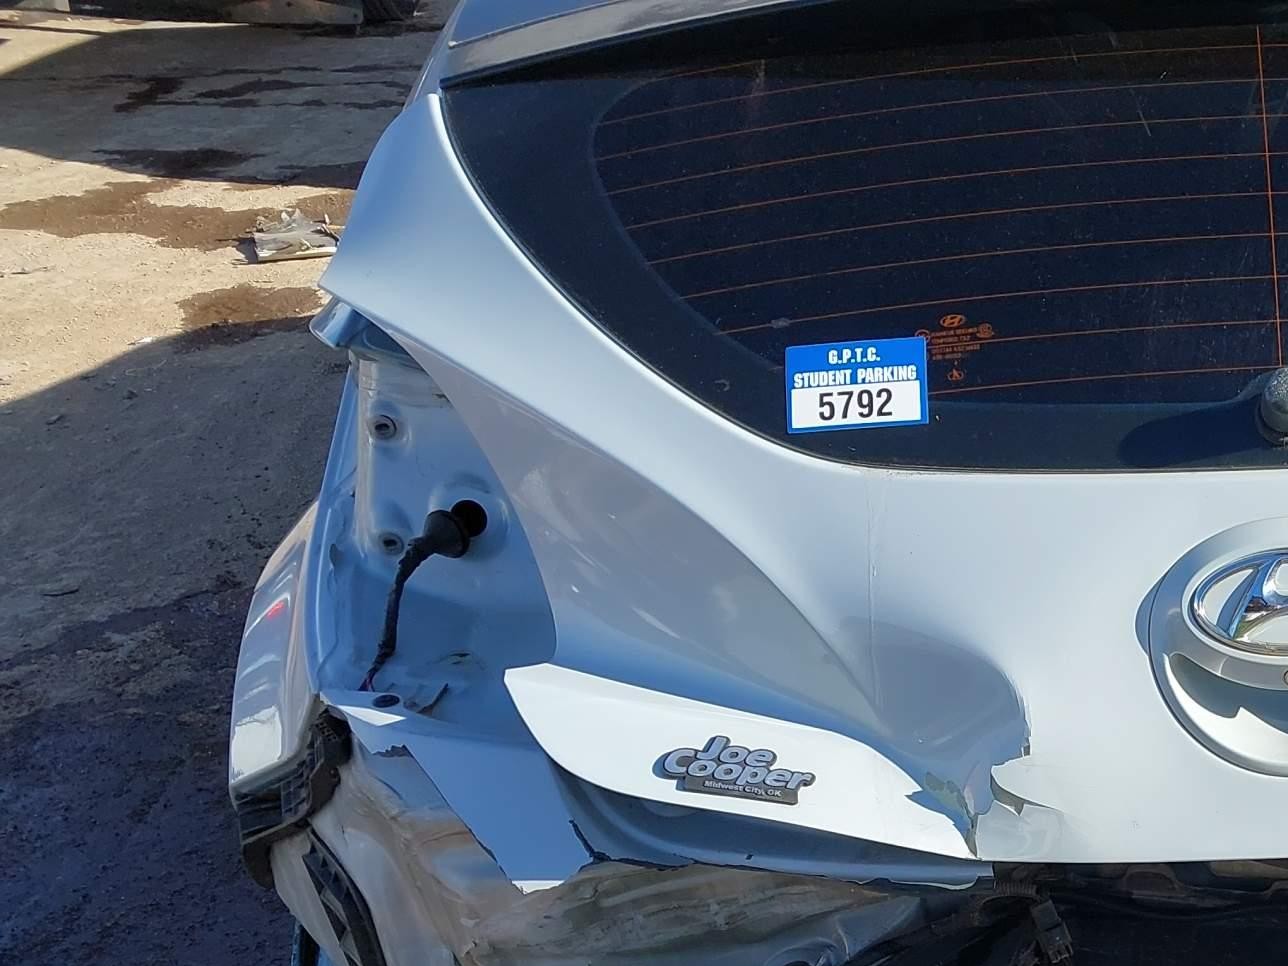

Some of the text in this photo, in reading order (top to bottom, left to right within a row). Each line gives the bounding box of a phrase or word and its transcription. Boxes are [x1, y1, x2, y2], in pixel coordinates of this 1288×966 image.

[828, 346, 881, 365] G.P.T.C.
[793, 364, 917, 389] STUDENT PARKING
[818, 387, 893, 421] 5792
[696, 736, 774, 767] Joe
[664, 749, 813, 789] Cooper
[703, 780, 744, 792] Midwest
[767, 788, 783, 797] OK
